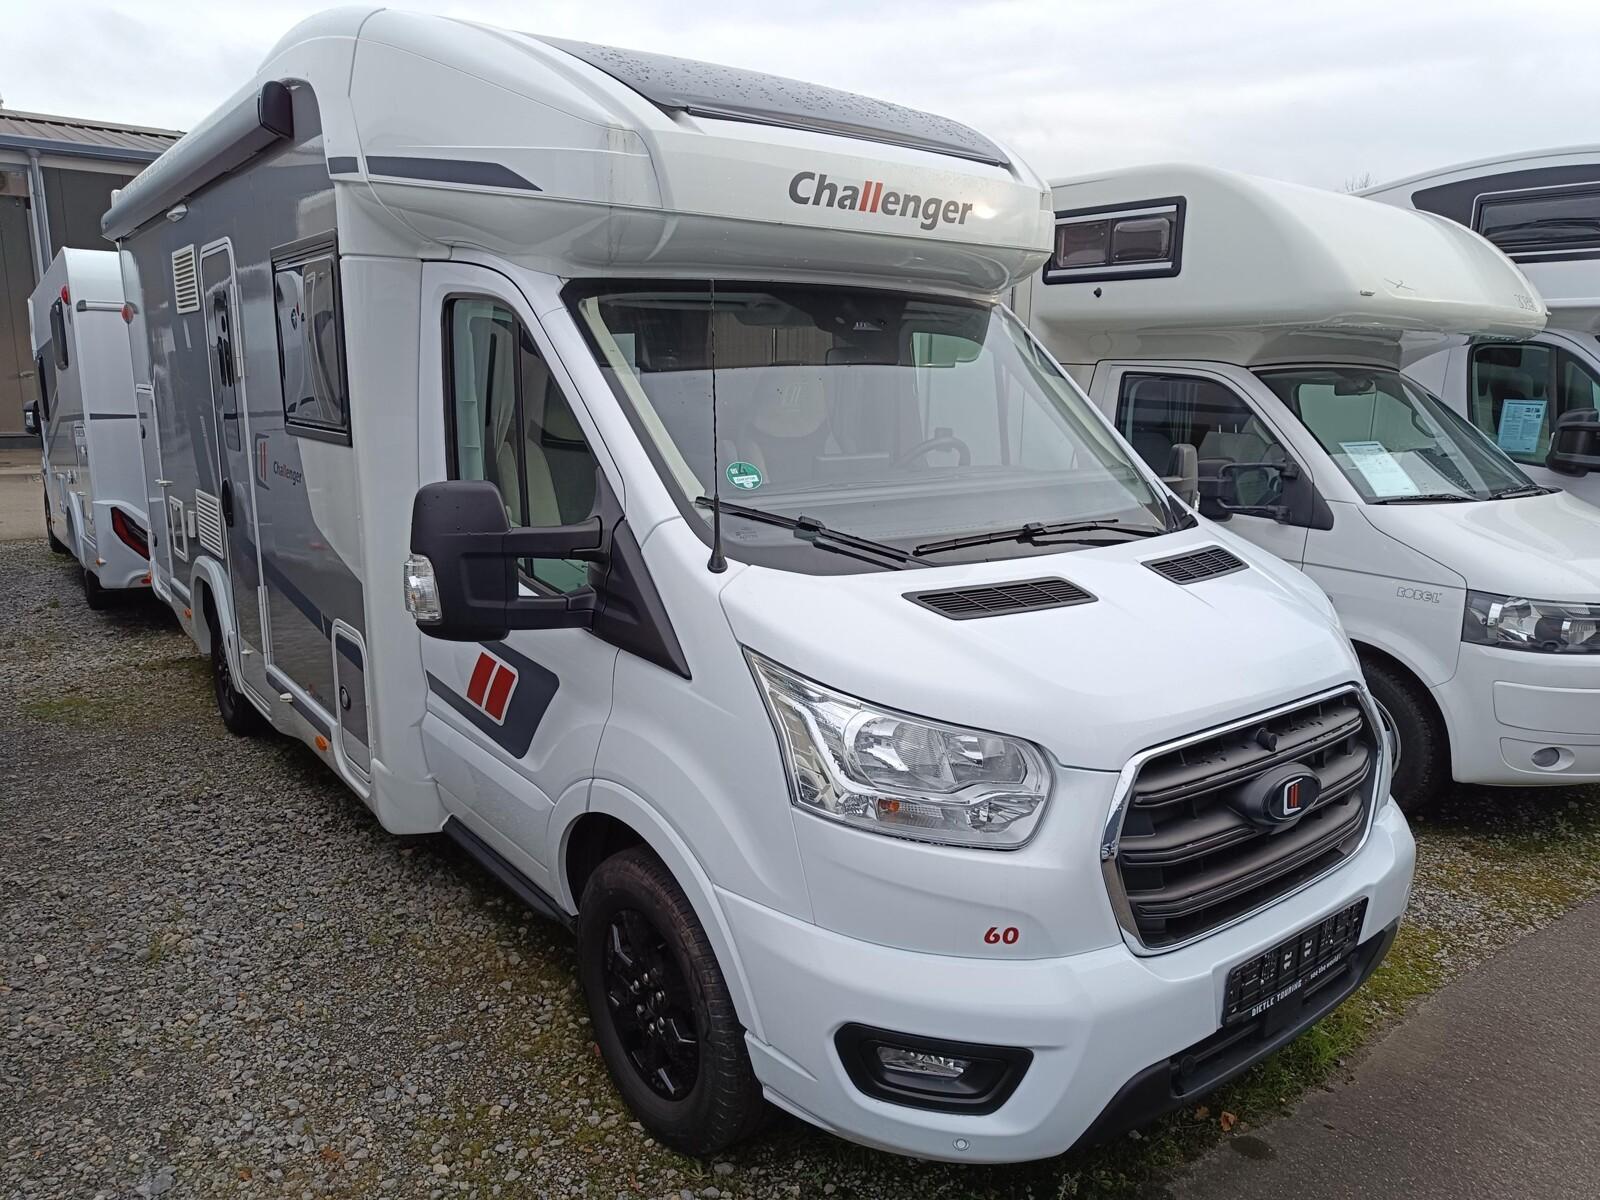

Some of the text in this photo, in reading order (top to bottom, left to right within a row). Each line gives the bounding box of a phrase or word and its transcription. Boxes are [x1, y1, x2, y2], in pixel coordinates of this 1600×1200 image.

[788, 171, 973, 231] Challenger
[273, 461, 302, 486] Challenger
[984, 927, 1019, 945] 60
[1251, 998, 1275, 1016] DIETLE
[1276, 980, 1302, 1002] TOURING
